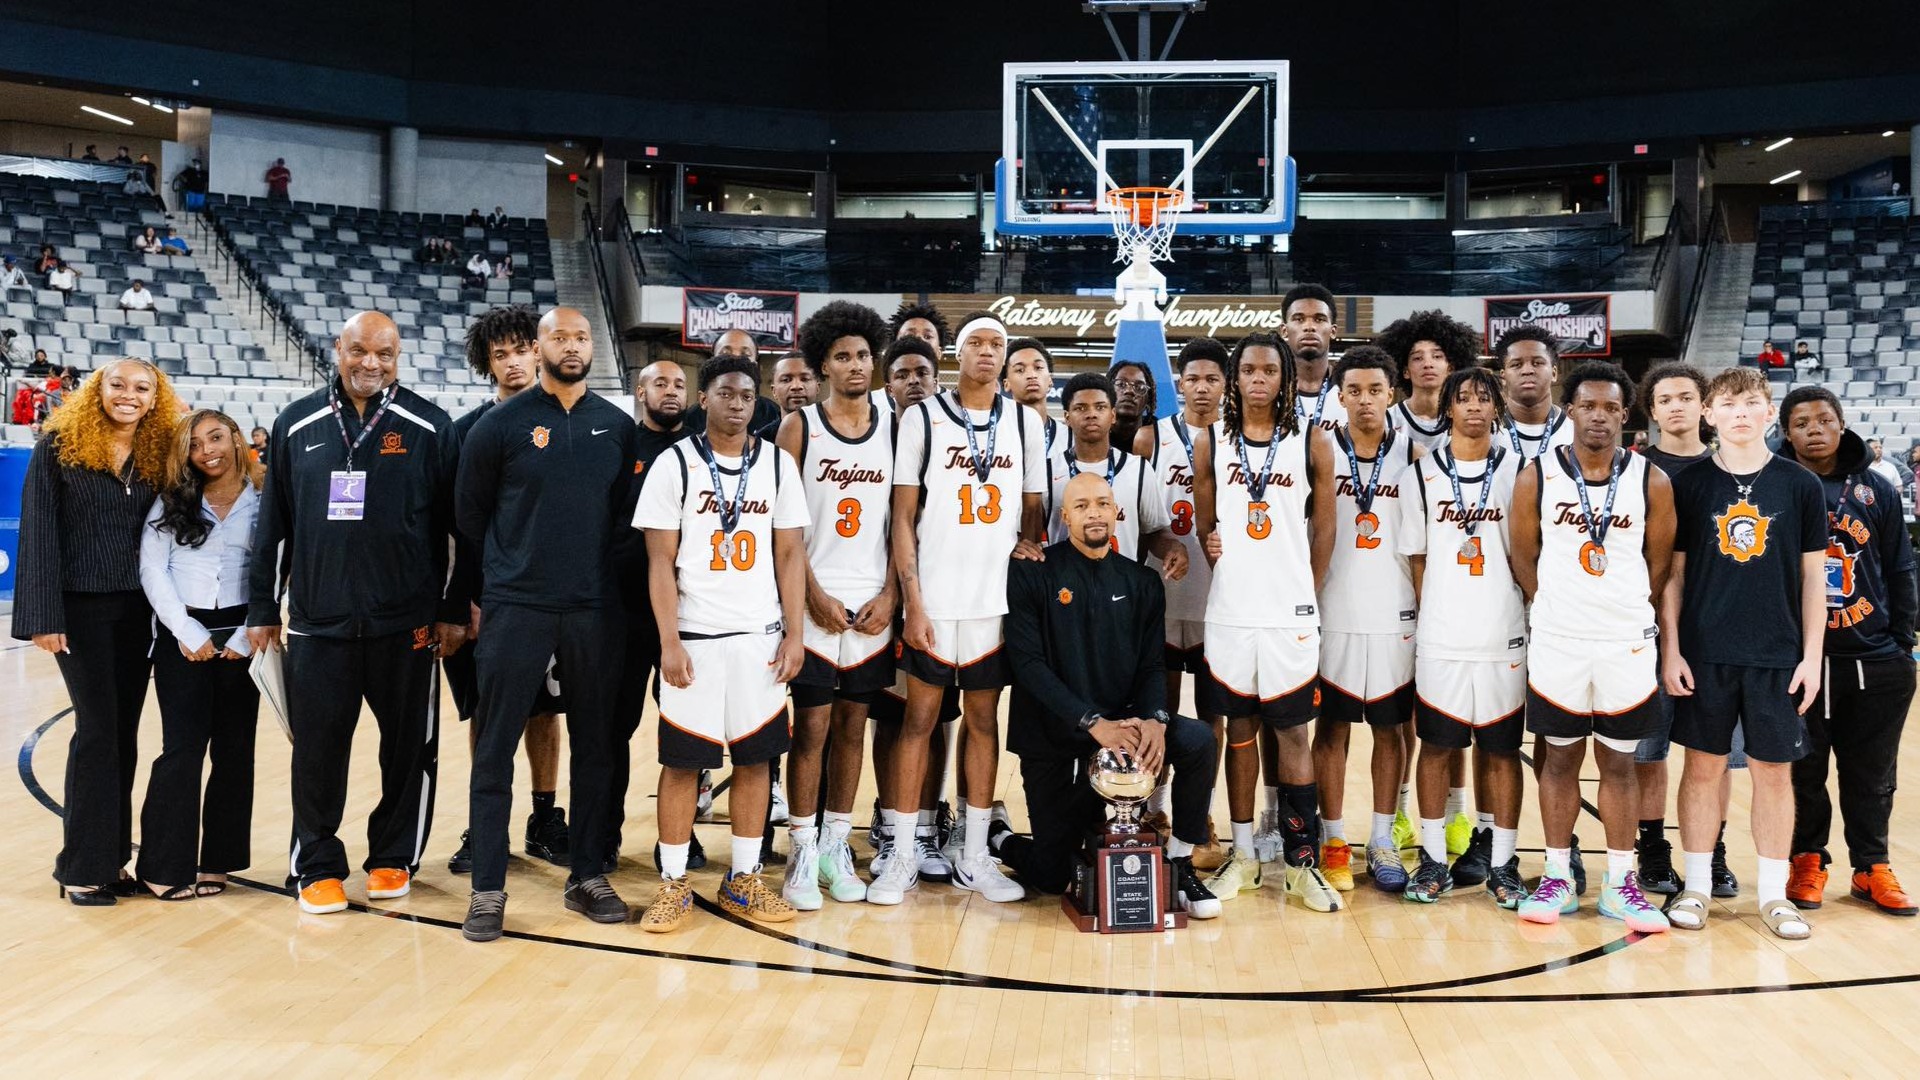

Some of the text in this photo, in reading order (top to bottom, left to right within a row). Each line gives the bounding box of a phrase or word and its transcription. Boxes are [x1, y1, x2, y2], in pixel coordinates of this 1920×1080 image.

[717, 292, 763, 314] State
[1163, 296, 1282, 337] hampions
[1520, 299, 1570, 322] State
[688, 308, 792, 340] CHAMPIONSHIPS
[1490, 315, 1605, 347] CHONSHIPS
[816, 458, 885, 490] Trojans
[945, 446, 1013, 477] Trojns
[958, 484, 1003, 524] 13
[1336, 474, 1399, 504] Trans
[835, 497, 862, 538] 3
[1247, 501, 1273, 541] 5
[1354, 511, 1381, 550] 2
[710, 529, 757, 571] 10
[1457, 536, 1485, 576] 4
